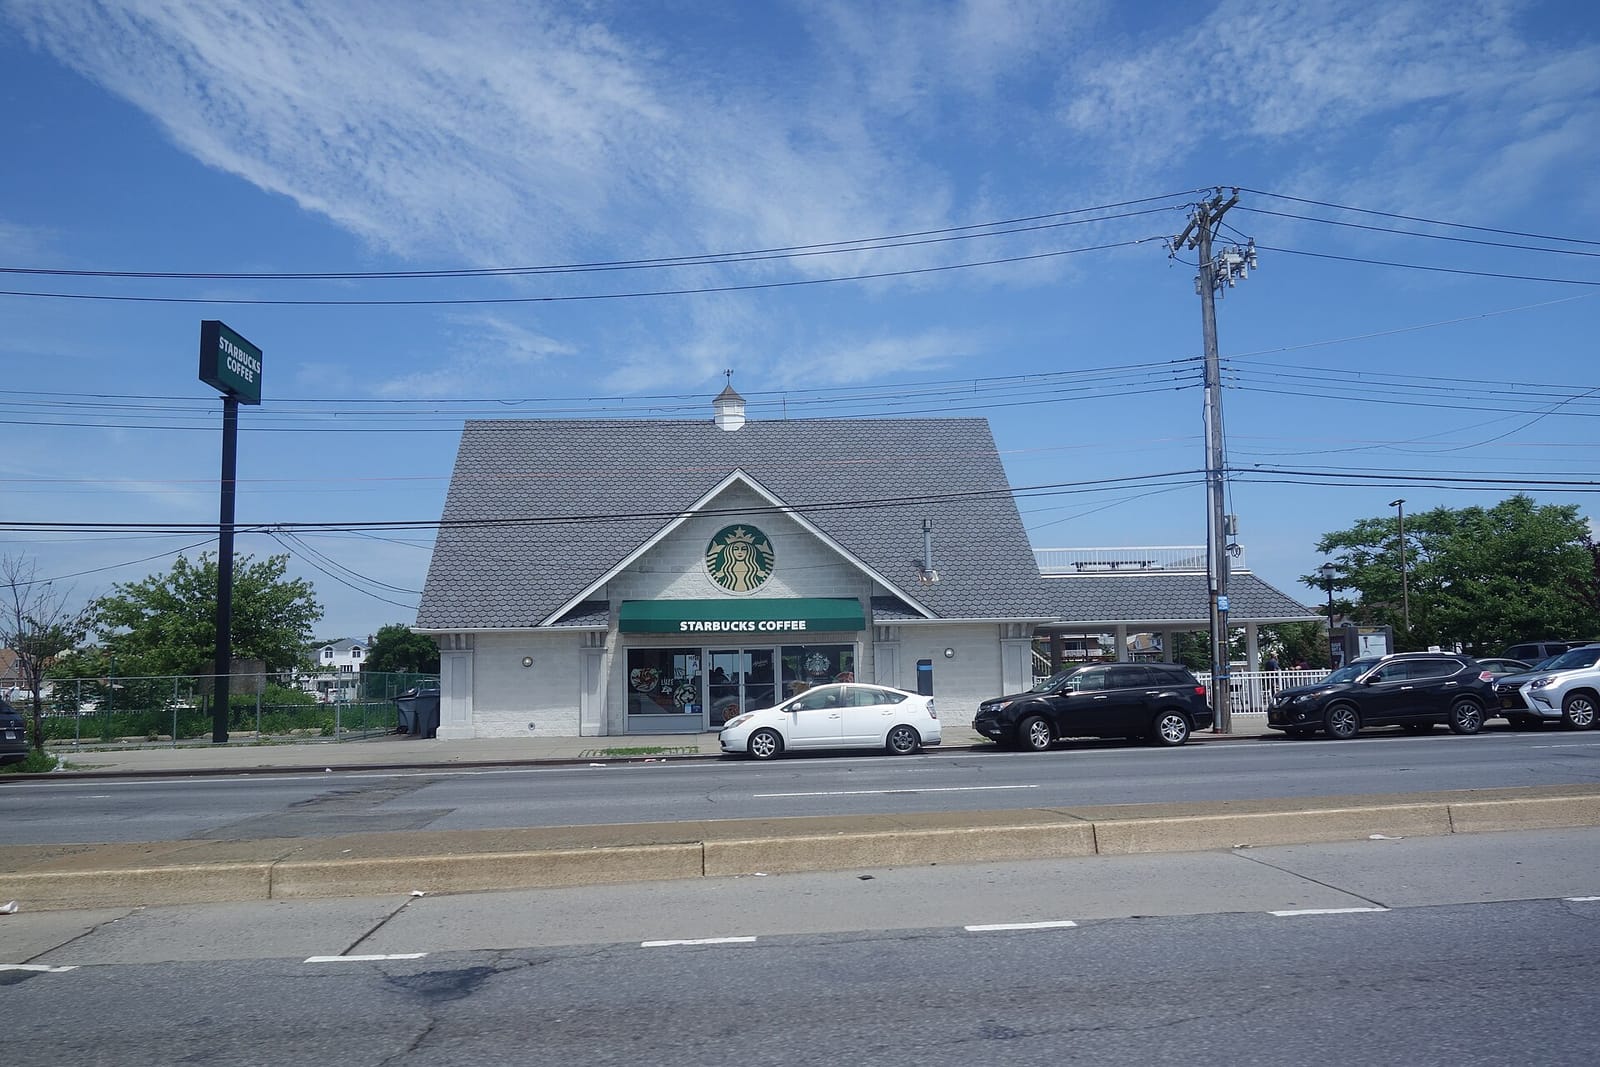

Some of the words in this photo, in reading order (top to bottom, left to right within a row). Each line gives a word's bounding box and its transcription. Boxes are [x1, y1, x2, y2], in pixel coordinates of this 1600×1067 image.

[219, 336, 261, 374] STARBUCKS
[227, 357, 254, 383] COFFEE
[680, 621, 756, 631] STARBUCKS
[758, 620, 806, 630] COFFEE
